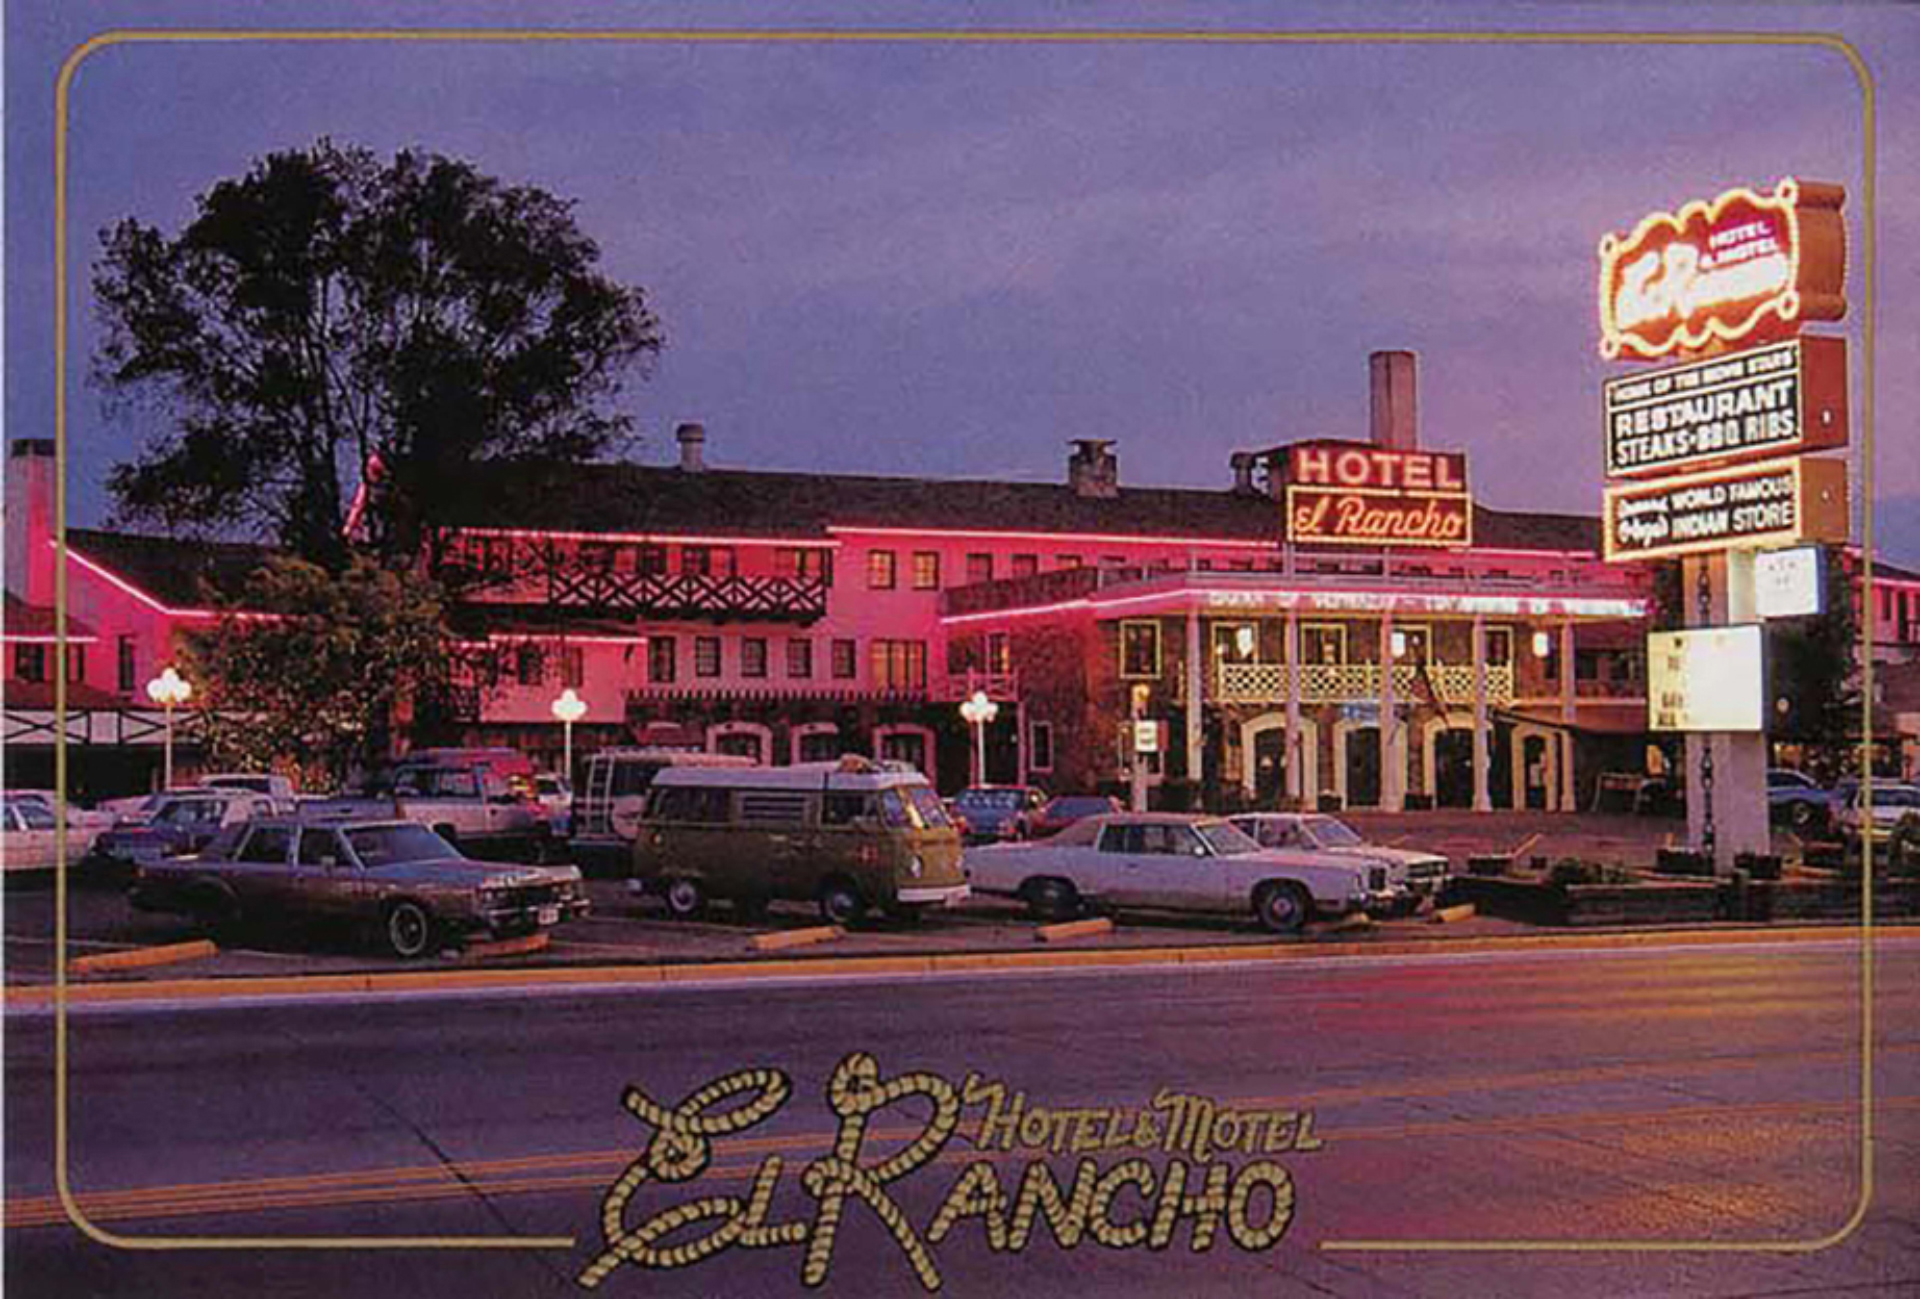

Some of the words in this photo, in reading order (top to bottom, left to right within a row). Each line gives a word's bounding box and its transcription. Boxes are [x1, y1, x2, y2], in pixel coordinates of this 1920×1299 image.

[1616, 380, 1793, 439] RESTAURANT
[1745, 408, 1795, 442] RIBS
[1298, 450, 1462, 489] HOTEL
[1671, 485, 1727, 509] WORLD
[1729, 478, 1792, 503] FAMOUS
[1335, 496, 1463, 537] Rancho
[1733, 500, 1792, 532] STORE
